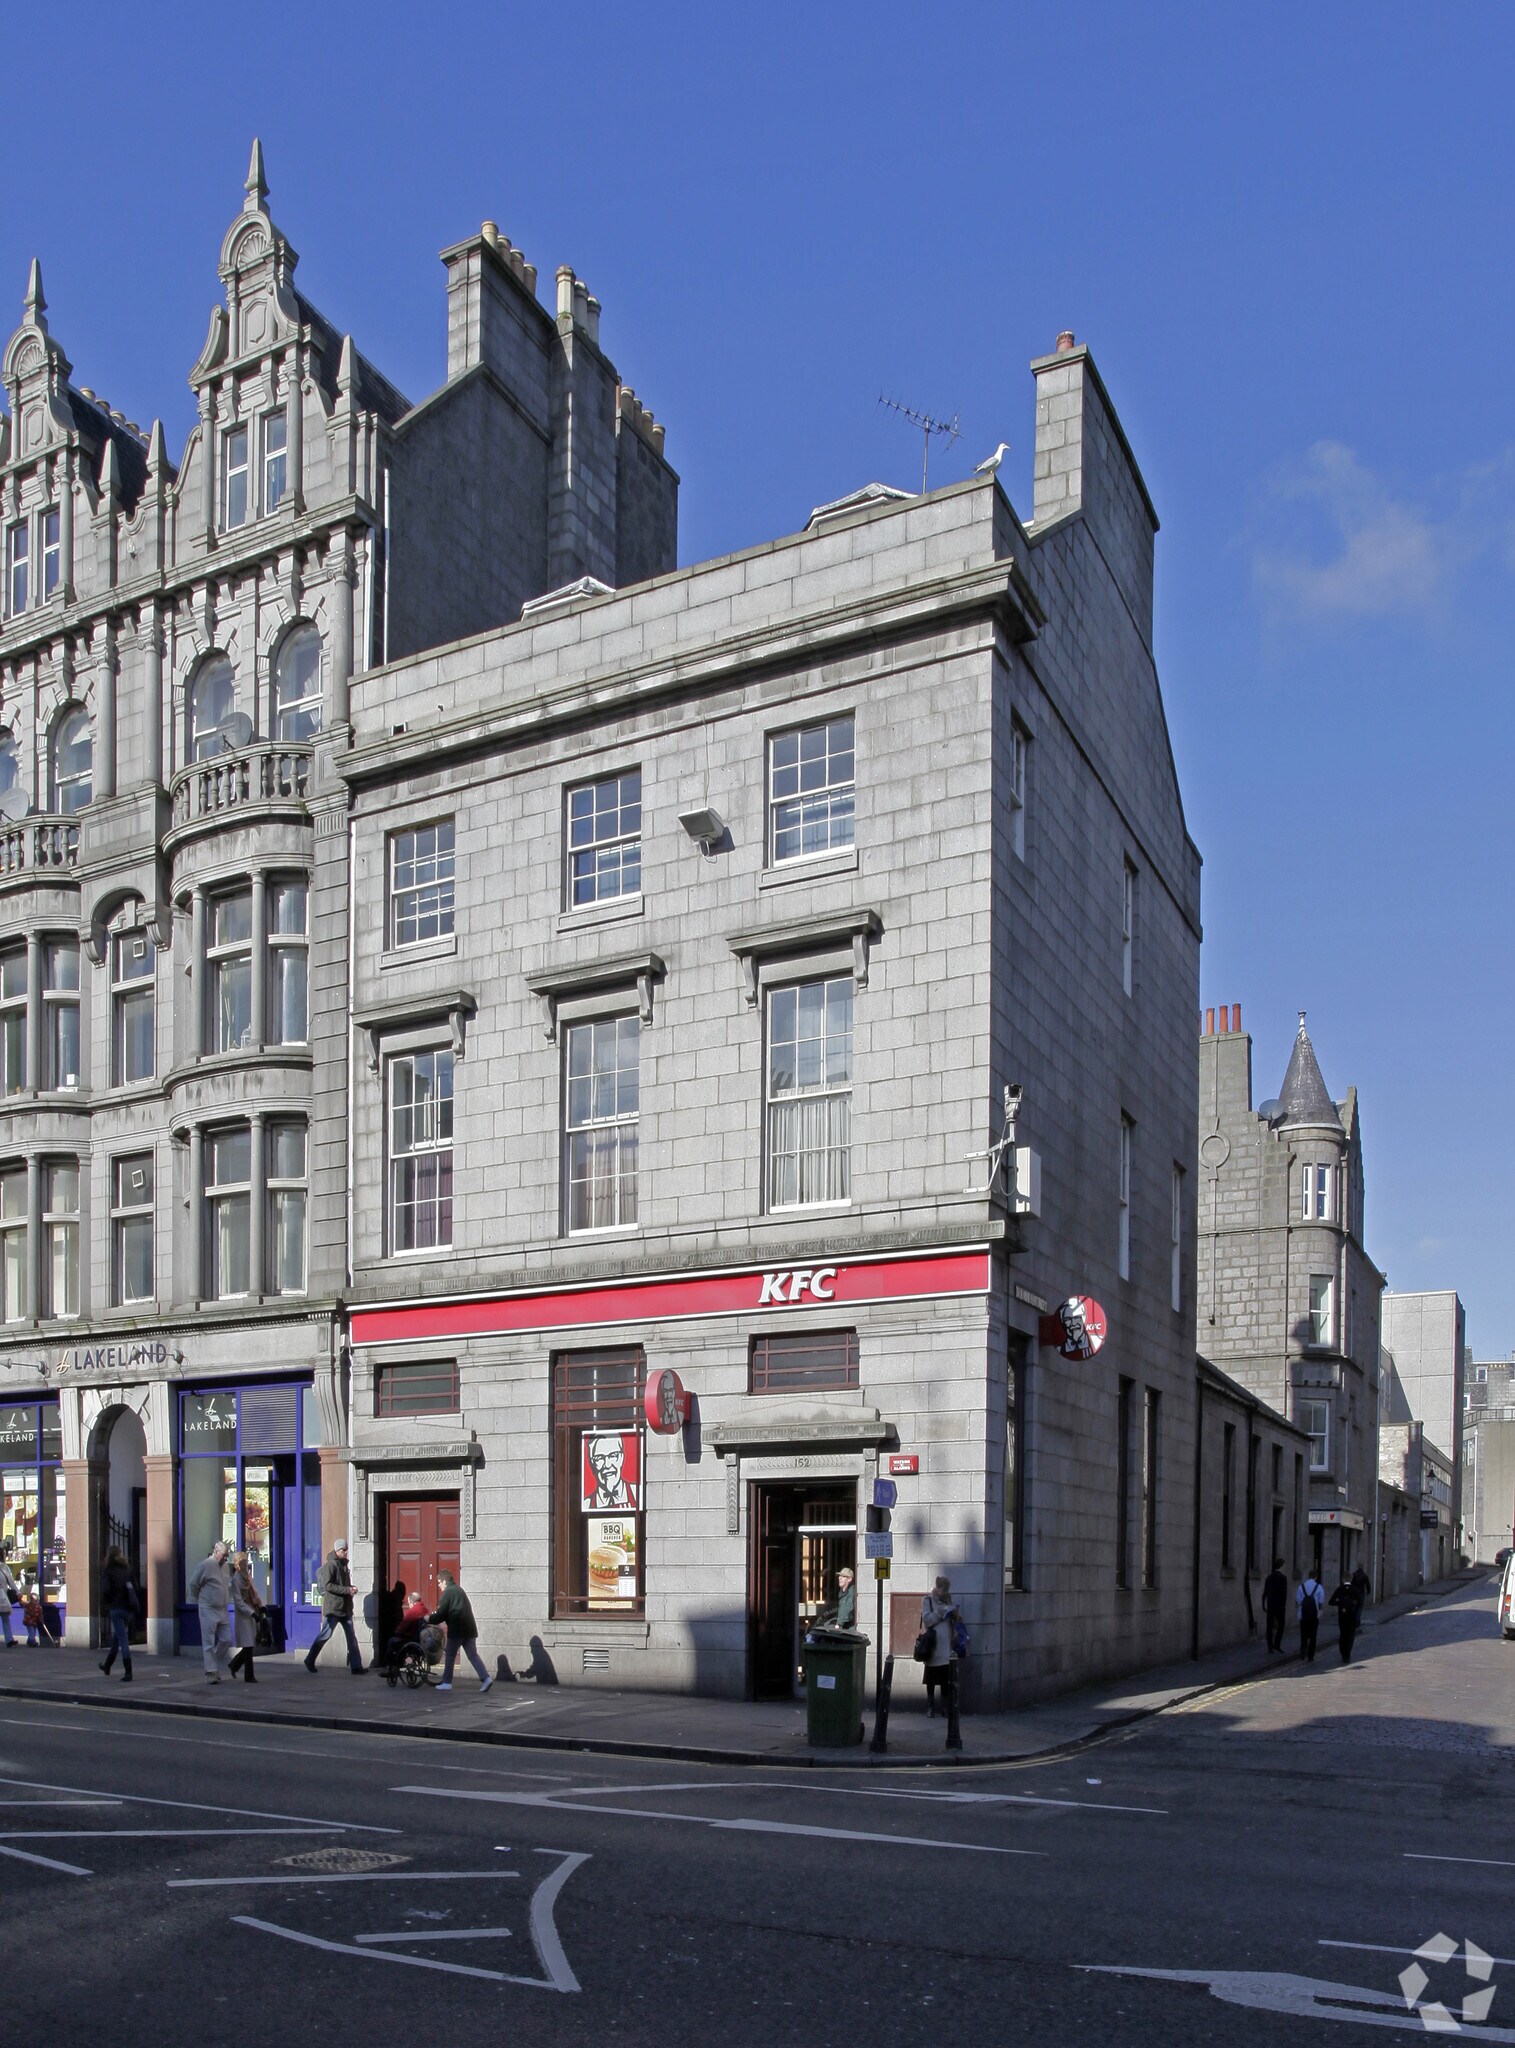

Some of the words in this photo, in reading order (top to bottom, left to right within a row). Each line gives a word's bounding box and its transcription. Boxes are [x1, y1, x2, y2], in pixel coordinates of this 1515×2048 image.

[758, 1268, 836, 1303] KFC
[1086, 1323, 1101, 1331] KFC
[74, 1343, 167, 1371] LAKELAND
[184, 1420, 237, 1432] LAKELAND
[603, 1524, 621, 1535] BBQ
[876, 1560, 889, 1578] H
